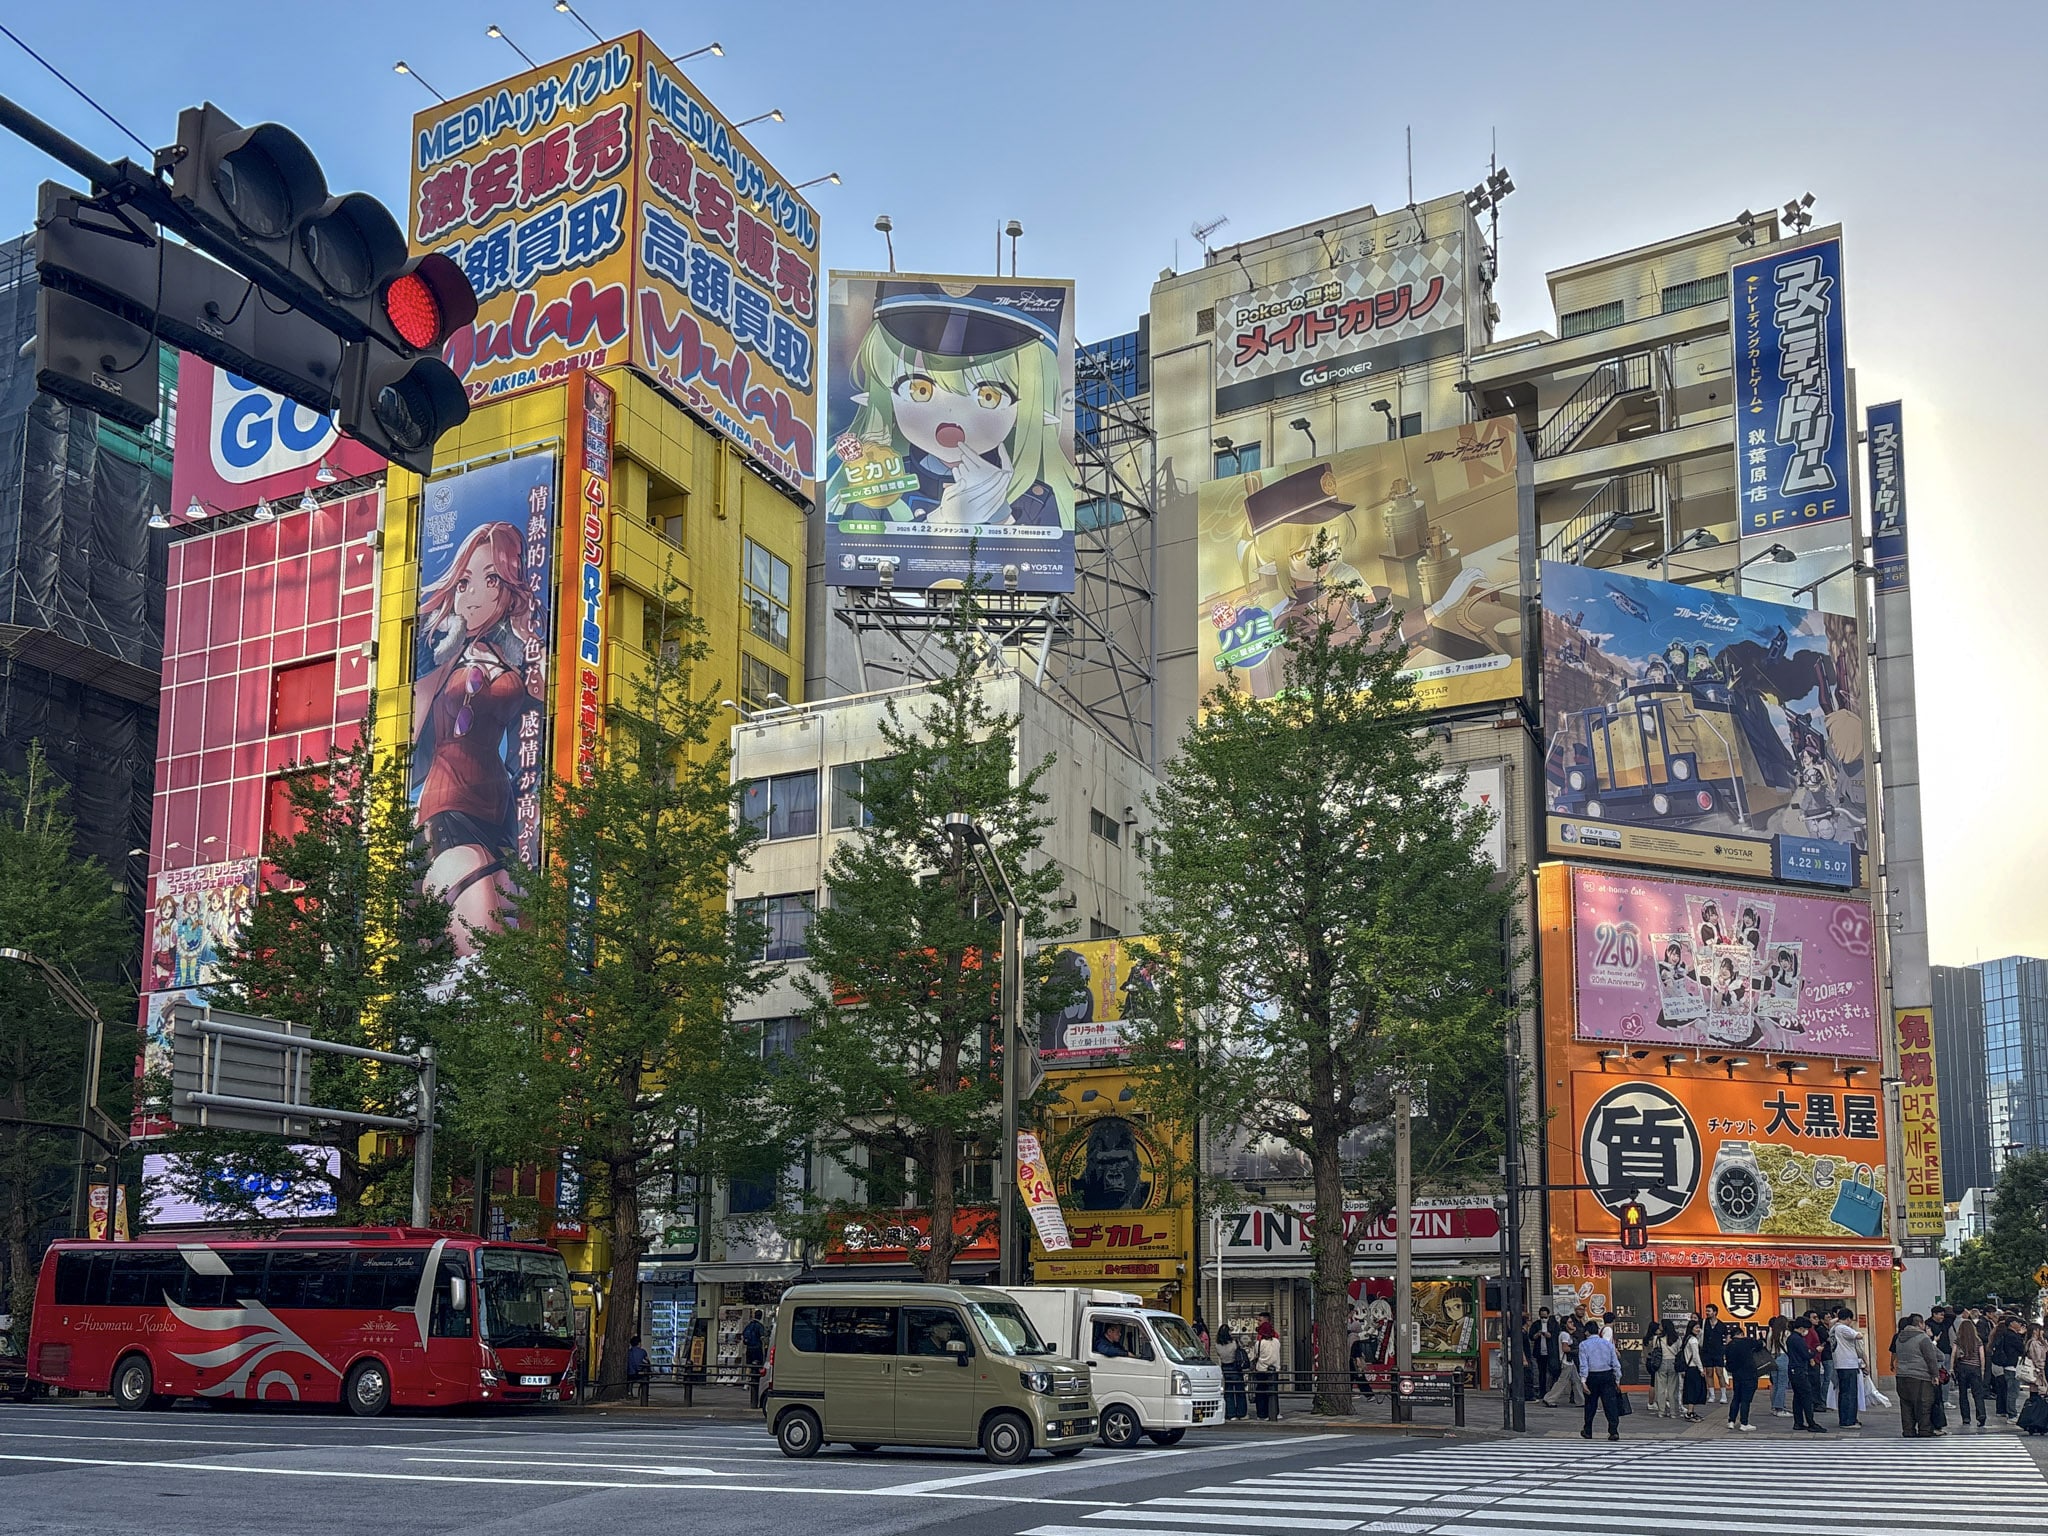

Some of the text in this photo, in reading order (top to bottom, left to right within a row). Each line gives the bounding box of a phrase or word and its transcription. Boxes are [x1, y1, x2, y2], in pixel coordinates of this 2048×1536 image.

[418, 44, 632, 170] MEDIAリサイクル
[419, 104, 628, 241] 激安販売
[646, 61, 817, 249] MEDIAリサイクル
[648, 119, 816, 326] 激安販売
[642, 203, 813, 392] 高額買取
[1237, 281, 1342, 327] Pokerの聖地
[1235, 275, 1445, 368] メイドカジノ
[1747, 284, 1764, 406] トレーディングカードゲーム
[490, 369, 537, 396] AKIBA
[640, 288, 816, 477] Mulan
[658, 364, 714, 414] ムーラン
[713, 409, 753, 448] AKIBA
[845, 457, 902, 484] ヒカリ
[1747, 428, 1769, 503] 秋葉原店
[583, 477, 604, 567] ムーラン
[911, 525, 932, 533] 4.22
[1003, 527, 1018, 536] 5.7
[523, 486, 550, 693] 情熱的ないい色だ。
[1030, 563, 1064, 571] YOSTAR
[580, 564, 602, 666] AKIBA
[1221, 614, 1274, 651] ノゾミ
[1445, 664, 1461, 675] 5.7
[516, 709, 541, 872] 感情が高ぶる。
[1724, 846, 1753, 857] YOSTAR
[1788, 856, 1812, 869] 4.22
[1824, 860, 1847, 872] 5.07
[1595, 921, 1640, 969] 20
[1591, 975, 1646, 989] 20th Anniversary
[1807, 1024, 1855, 1043] これからも。
[1898, 1014, 1934, 1088] 免税
[1708, 1116, 1758, 1135] チケット
[1763, 1089, 1880, 1140] 大黒屋
[1596, 1104, 1692, 1206] 質
[1902, 1093, 1924, 1196] 면세점
[1920, 1093, 1941, 1196] TAX FREE
[1221, 1204, 1292, 1252] ZIN
[1411, 1212, 1451, 1237] ZIN
[1908, 1211, 1943, 1220] AKIHABARA
[1909, 1221, 1943, 1230] TOKIS
[362, 1256, 415, 1267] Hinomaru Kanko
[1554, 1263, 1607, 1279] 質 & 買取
[1590, 1248, 1636, 1264] 高価買取
[1727, 1277, 1757, 1314] 質
[73, 1312, 178, 1334] Hinomaru Kanko
